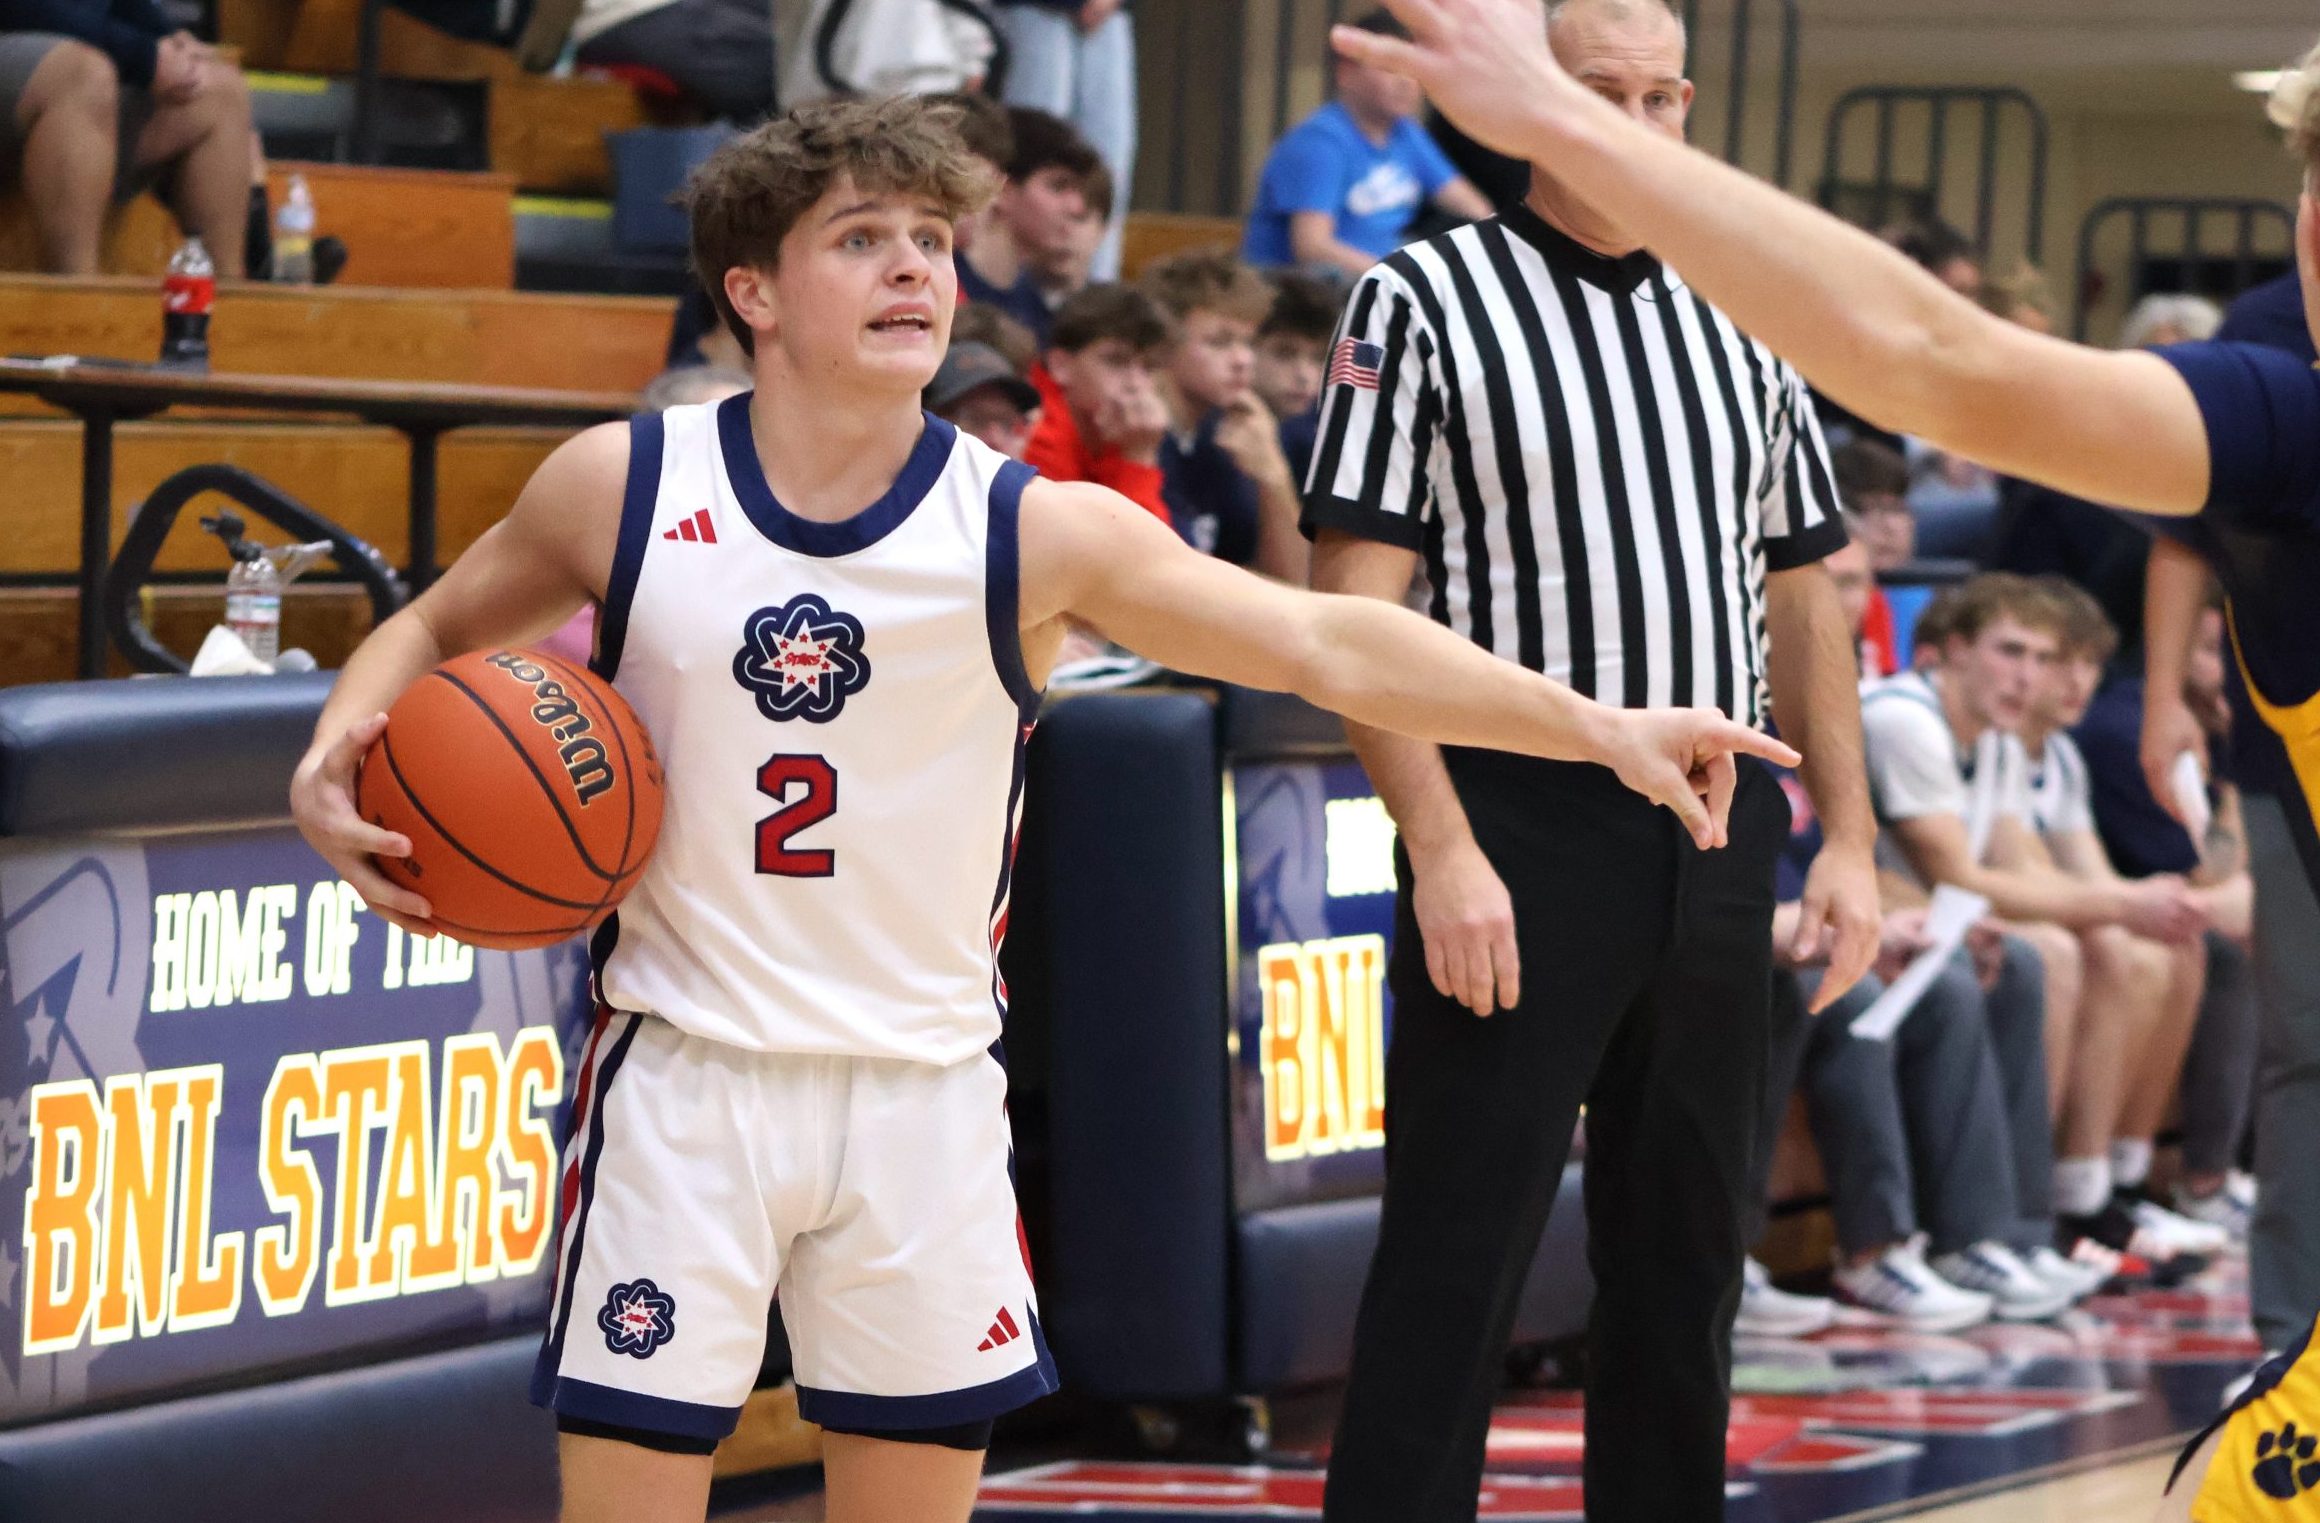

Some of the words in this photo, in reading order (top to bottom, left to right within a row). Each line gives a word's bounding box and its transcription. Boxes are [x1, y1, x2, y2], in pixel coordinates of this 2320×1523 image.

[486, 651, 616, 808] Wilson
[755, 753, 837, 877] 2
[150, 884, 297, 1012] HOME
[304, 880, 367, 996] OF
[23, 1063, 246, 1356] BNL
[252, 1026, 564, 1318] STARS
